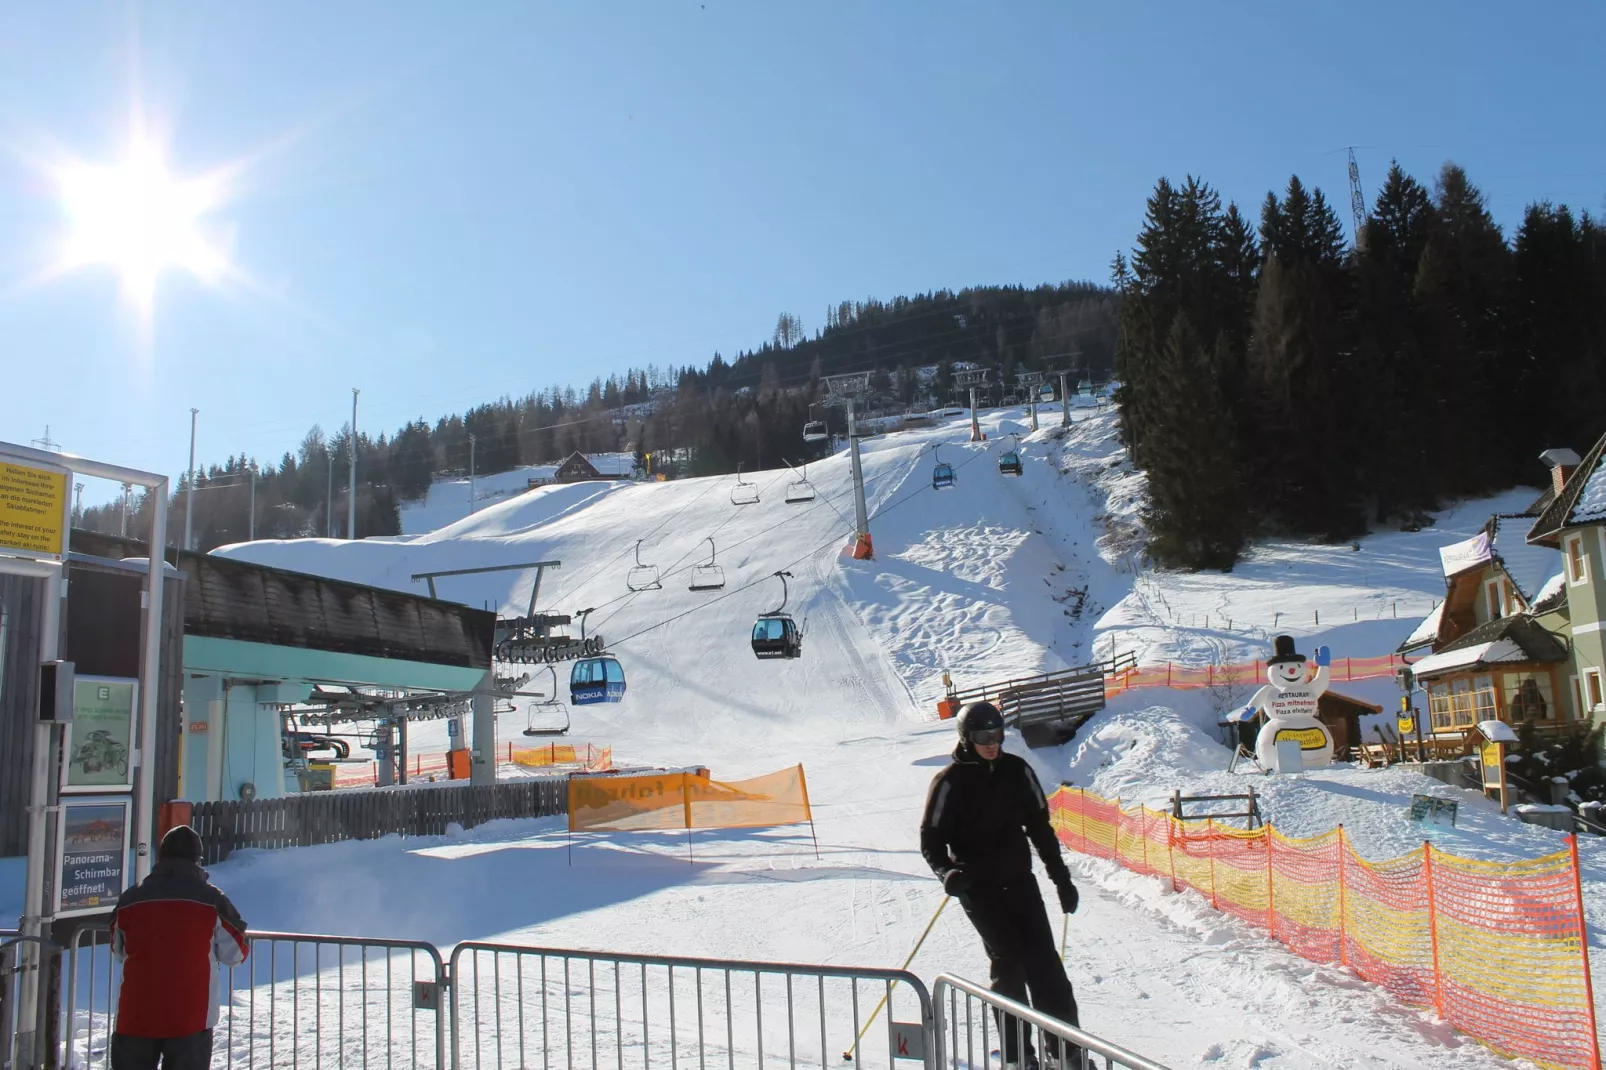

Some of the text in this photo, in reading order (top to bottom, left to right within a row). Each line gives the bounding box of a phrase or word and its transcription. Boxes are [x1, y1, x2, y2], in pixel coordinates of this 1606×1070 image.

[6, 467, 26, 476] Halten
[40, 482, 55, 490] Ihrer
[10, 521, 34, 531] interest
[42, 527, 57, 535] your
[16, 532, 30, 541] stay
[575, 691, 604, 700] NOKIA
[64, 854, 114, 867] Panorama-
[74, 867, 121, 880] Schirmbar
[62, 882, 105, 899] geöffnet!
